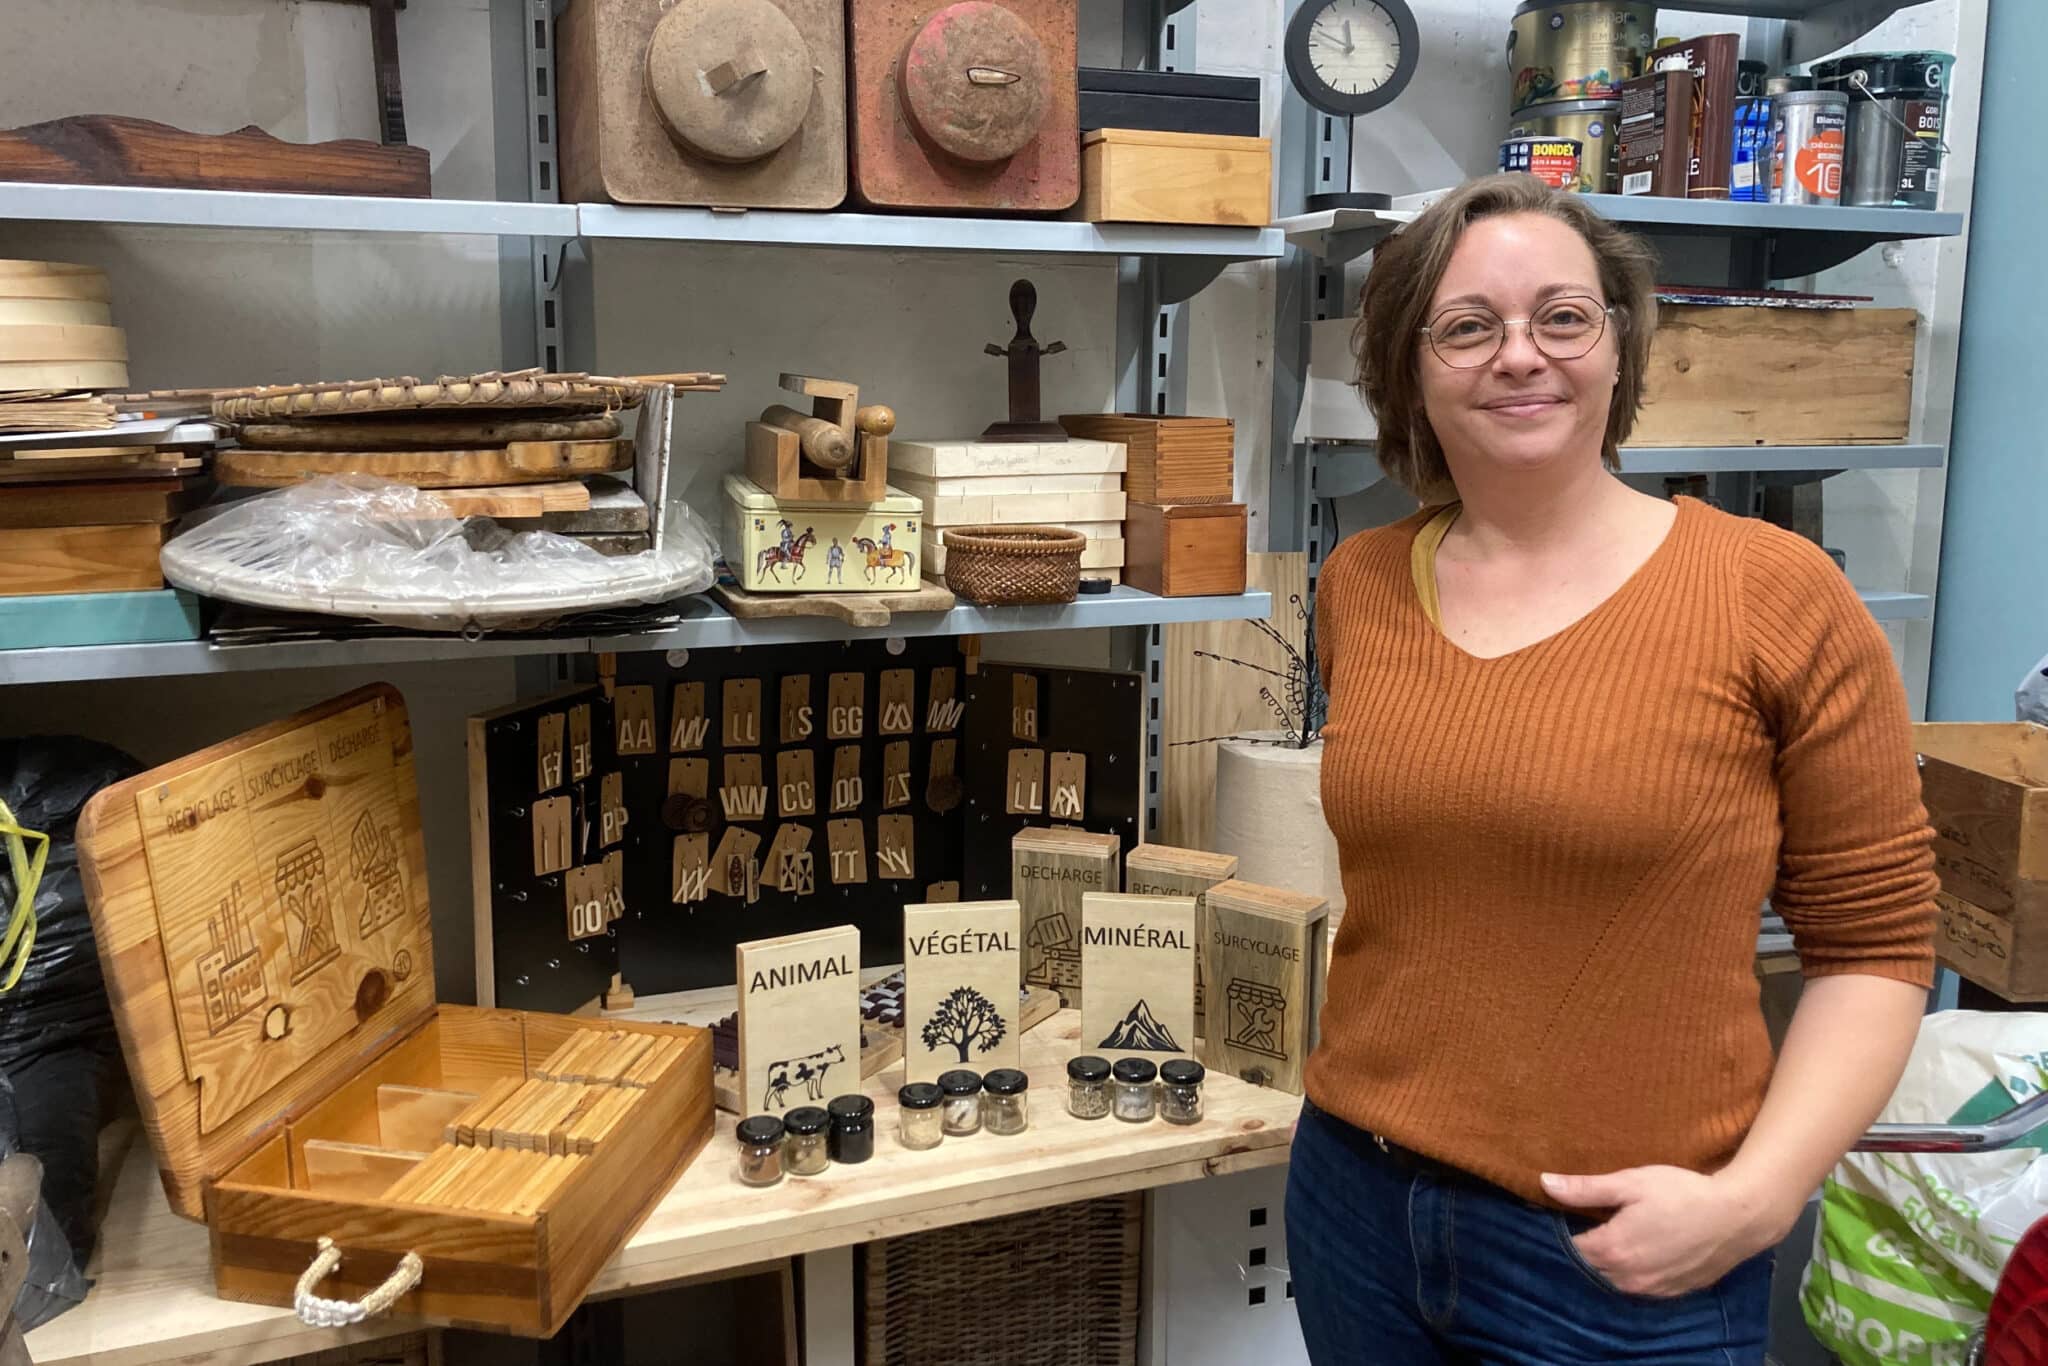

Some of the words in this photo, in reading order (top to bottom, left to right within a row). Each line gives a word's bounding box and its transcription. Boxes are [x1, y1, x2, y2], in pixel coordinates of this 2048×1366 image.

[1532, 144, 1575, 156] BONDEX
[1806, 162, 1841, 195] 10
[1900, 178, 1914, 189] 3L
[249, 750, 319, 801] SURCYCLAGE
[1021, 865, 1102, 885] DECHARGE
[909, 928, 1017, 957] VÉGÉTAL
[1084, 923, 1191, 950] MINÉRAL
[1214, 931, 1300, 962] SURCYCLAGE
[750, 954, 853, 994] ANIMAL
